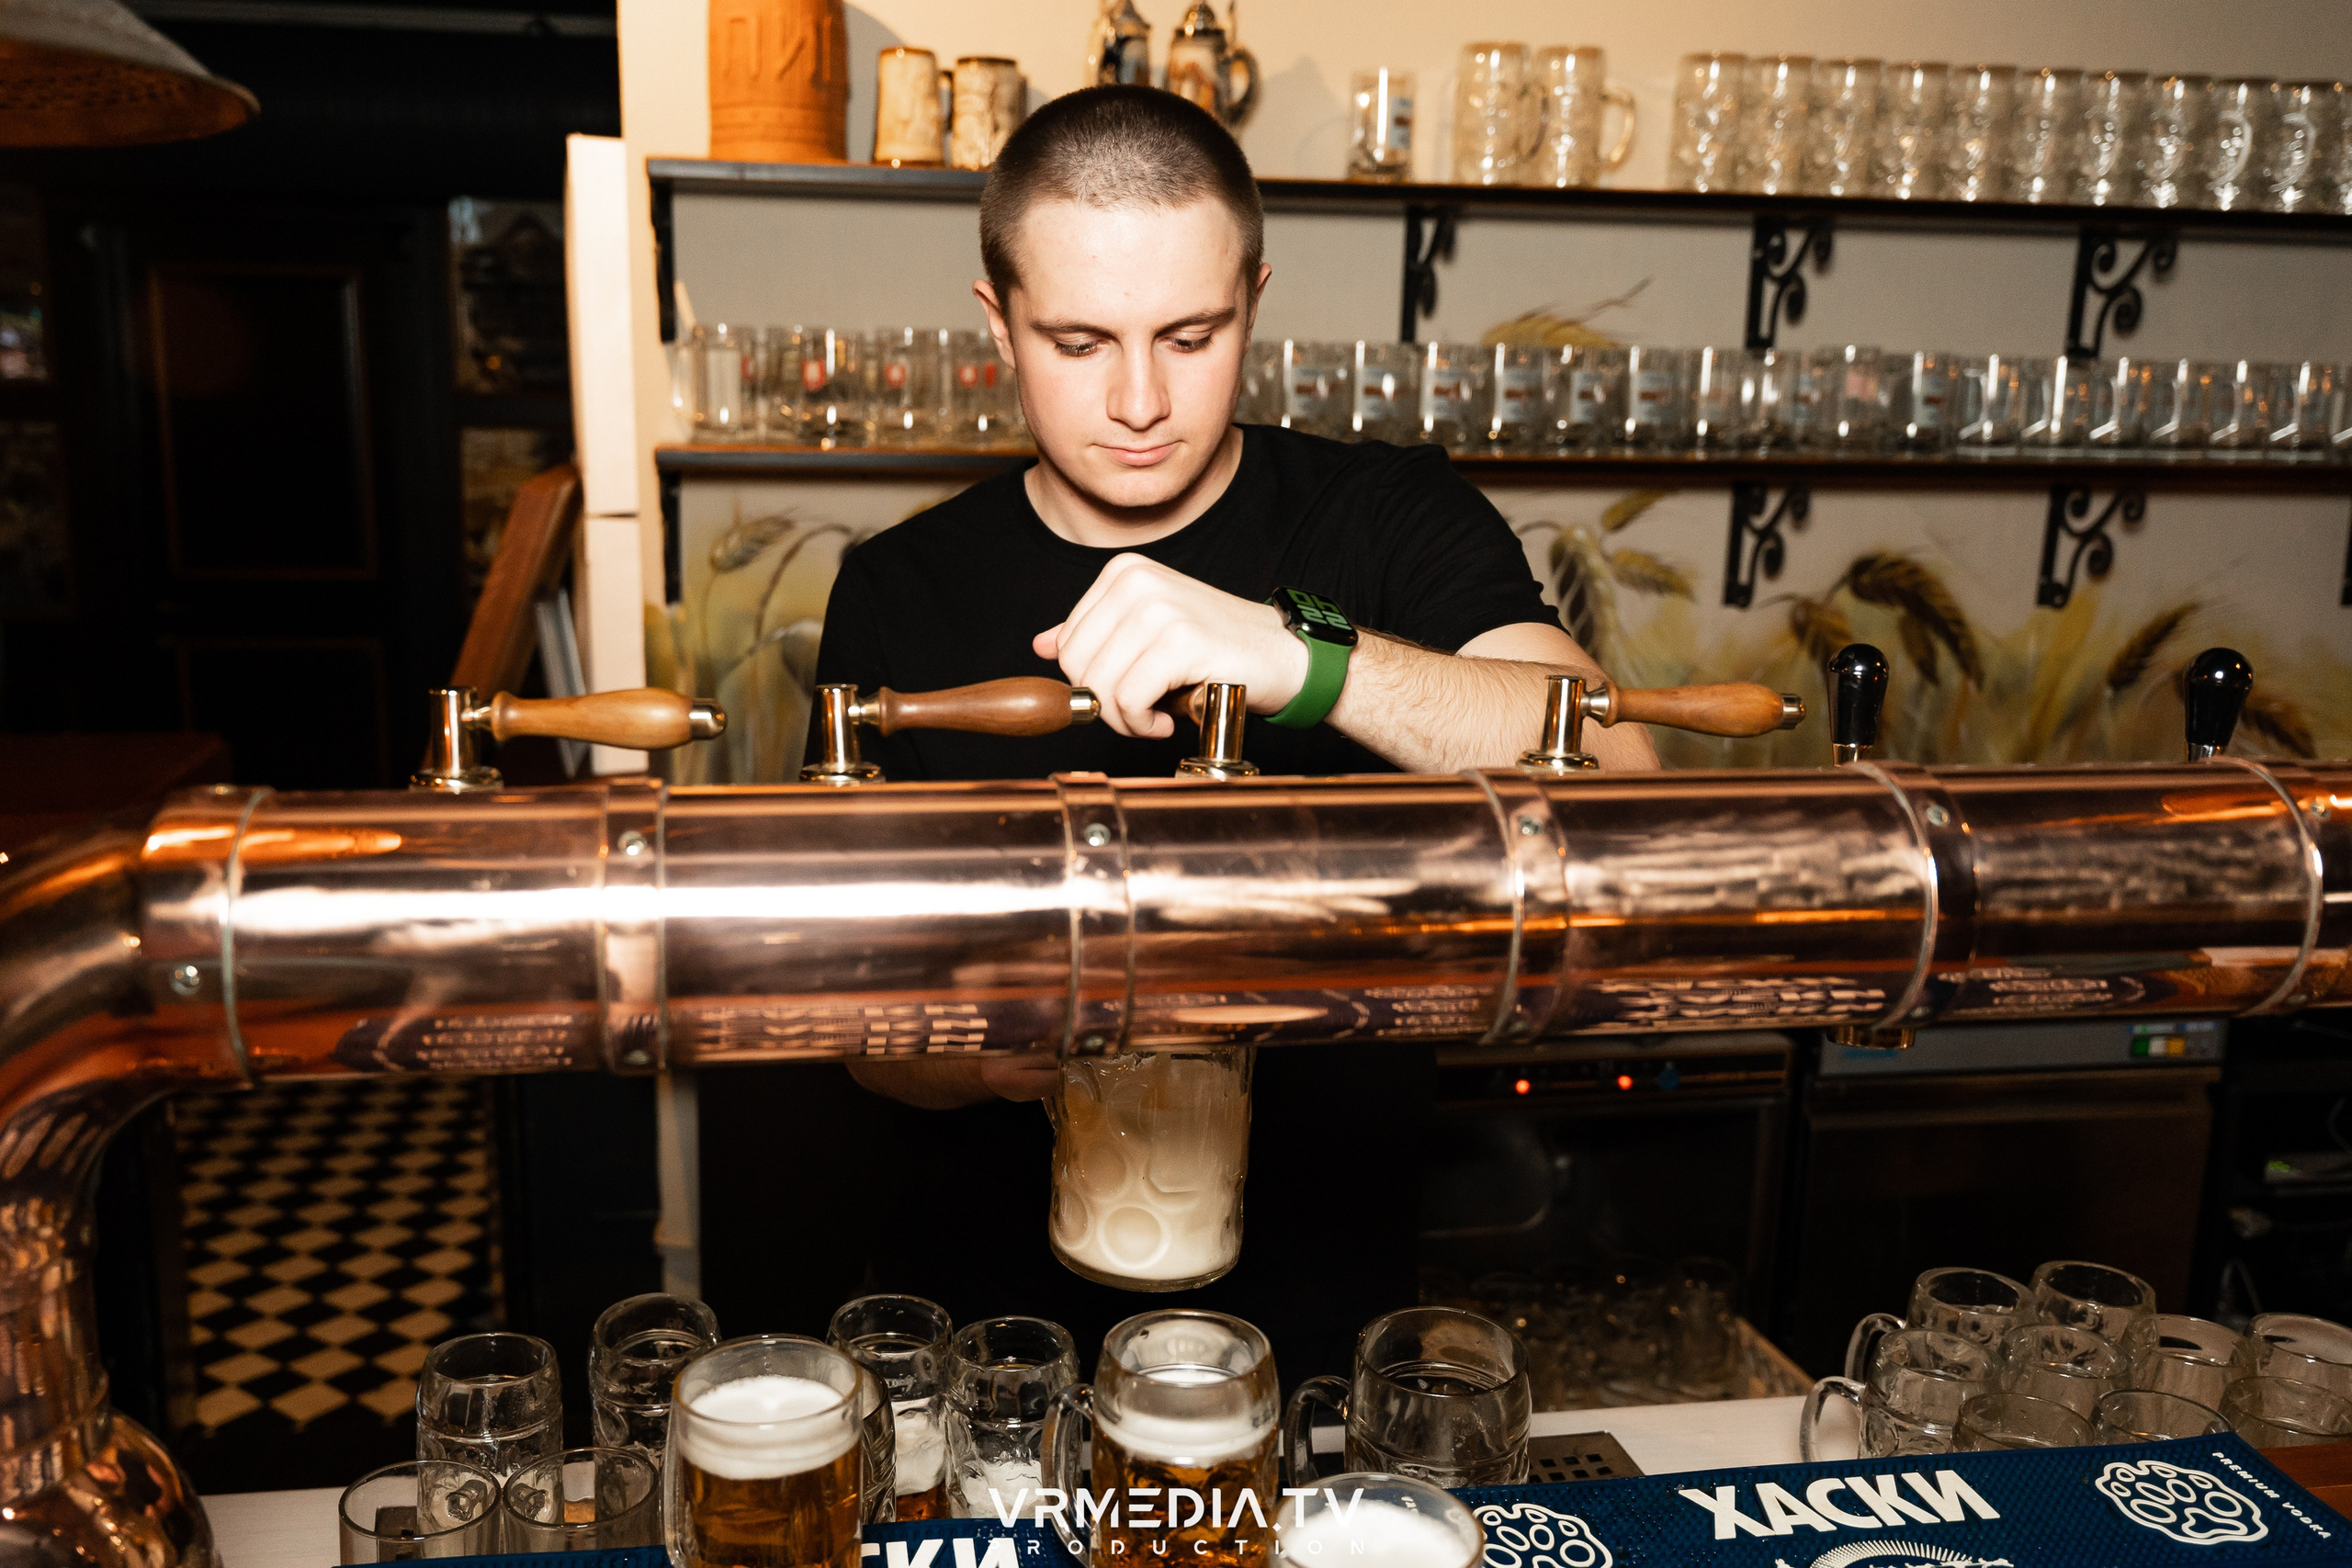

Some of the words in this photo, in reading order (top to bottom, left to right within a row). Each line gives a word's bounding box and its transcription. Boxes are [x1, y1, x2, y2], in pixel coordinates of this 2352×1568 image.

[1679, 1470, 2000, 1540] ХАСКИ
[2211, 1451, 2280, 1498] PREMIUM
[2282, 1502, 2332, 1539] VODKA
